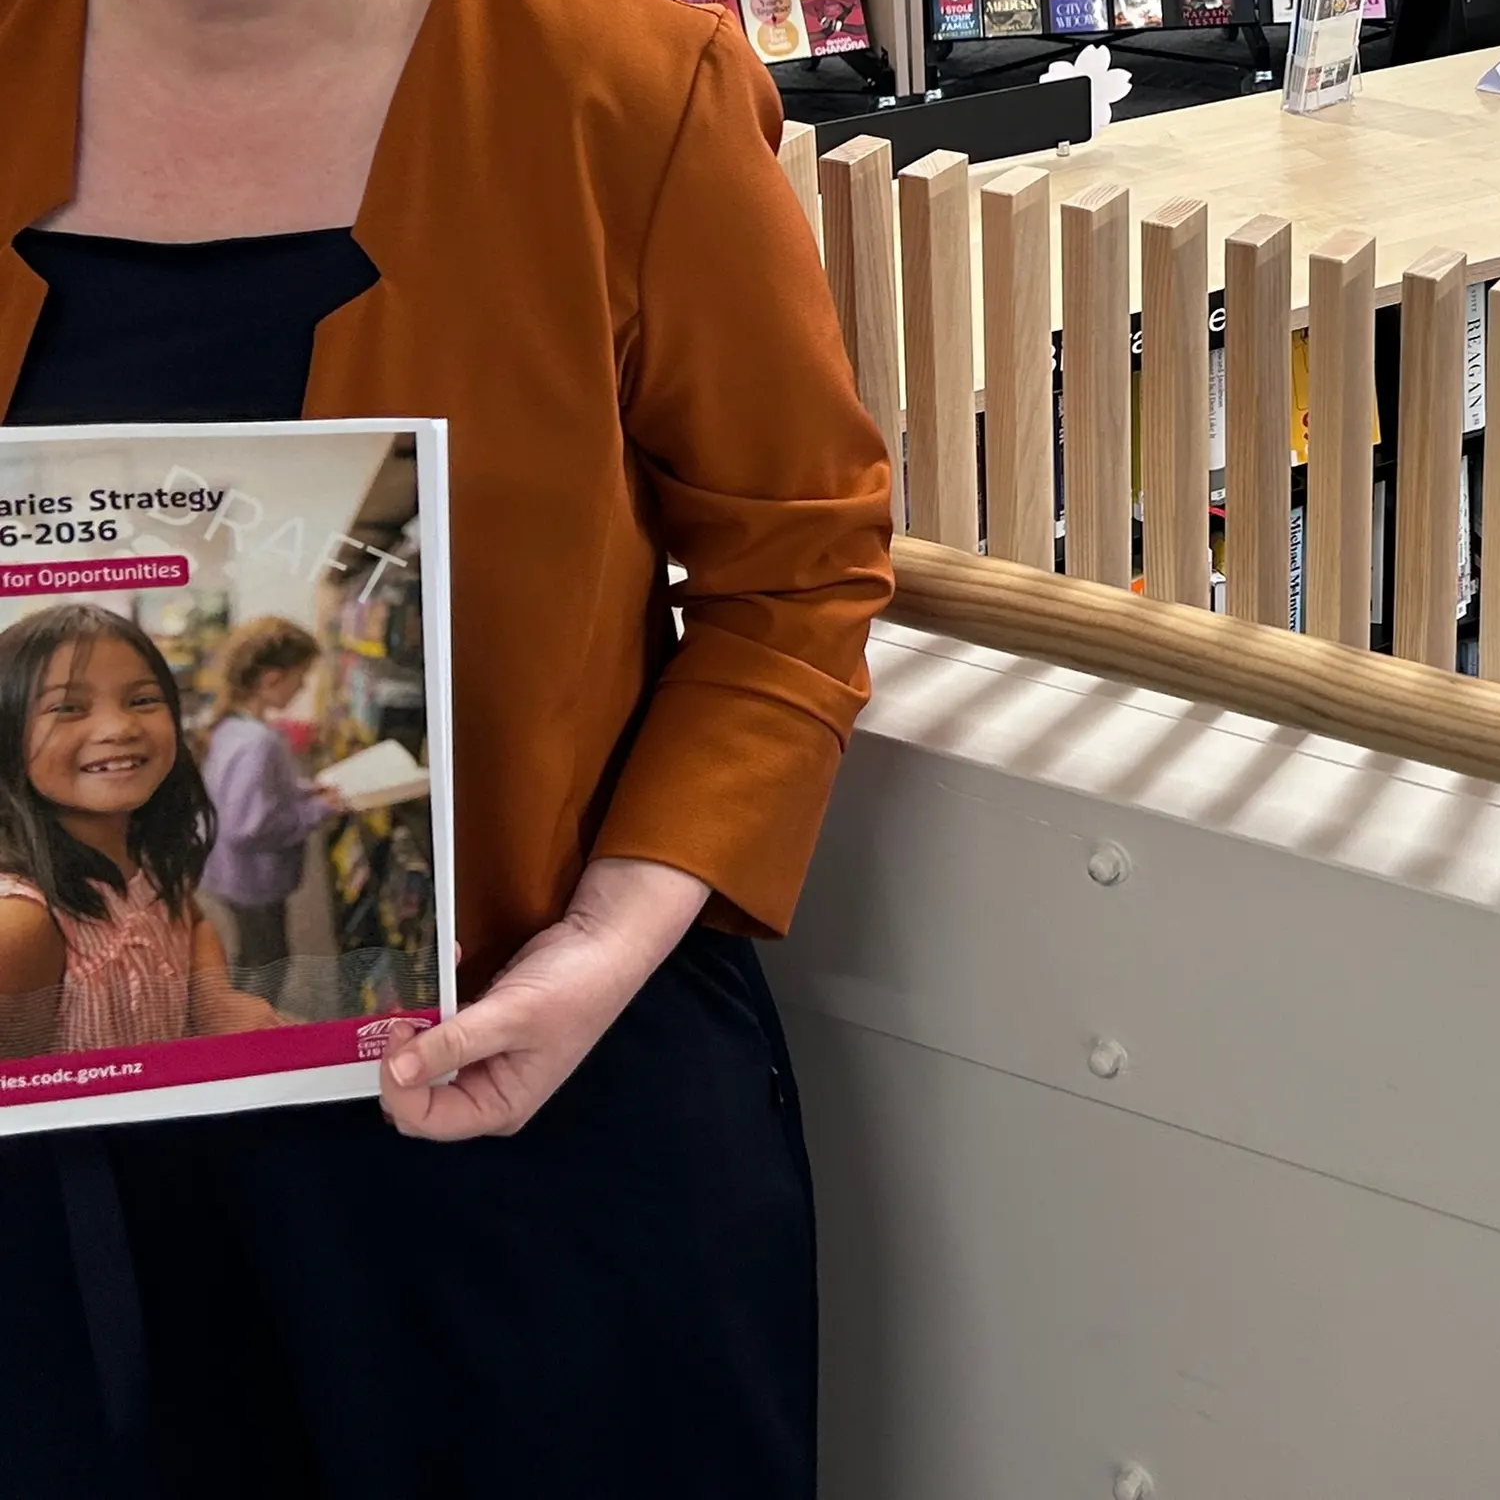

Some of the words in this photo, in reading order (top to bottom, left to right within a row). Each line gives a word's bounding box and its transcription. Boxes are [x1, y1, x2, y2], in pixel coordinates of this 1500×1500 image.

[940, 20, 976, 32] FAMILY
[945, 13, 972, 22] YOUR
[1056, 15, 1097, 29] WIDOW
[814, 38, 867, 57] CHANDRA
[1467, 318, 1482, 409] REAGAN
[0, 493, 73, 517] aries
[89, 487, 225, 512] Strategy
[0, 519, 118, 547] 6-2036
[149, 464, 408, 604] DRAFT
[1290, 516, 1301, 569] Michael
[3, 570, 34, 588] for
[38, 562, 181, 589] Opportunities
[0, 1061, 144, 1090] ies.codc.govt.nz
